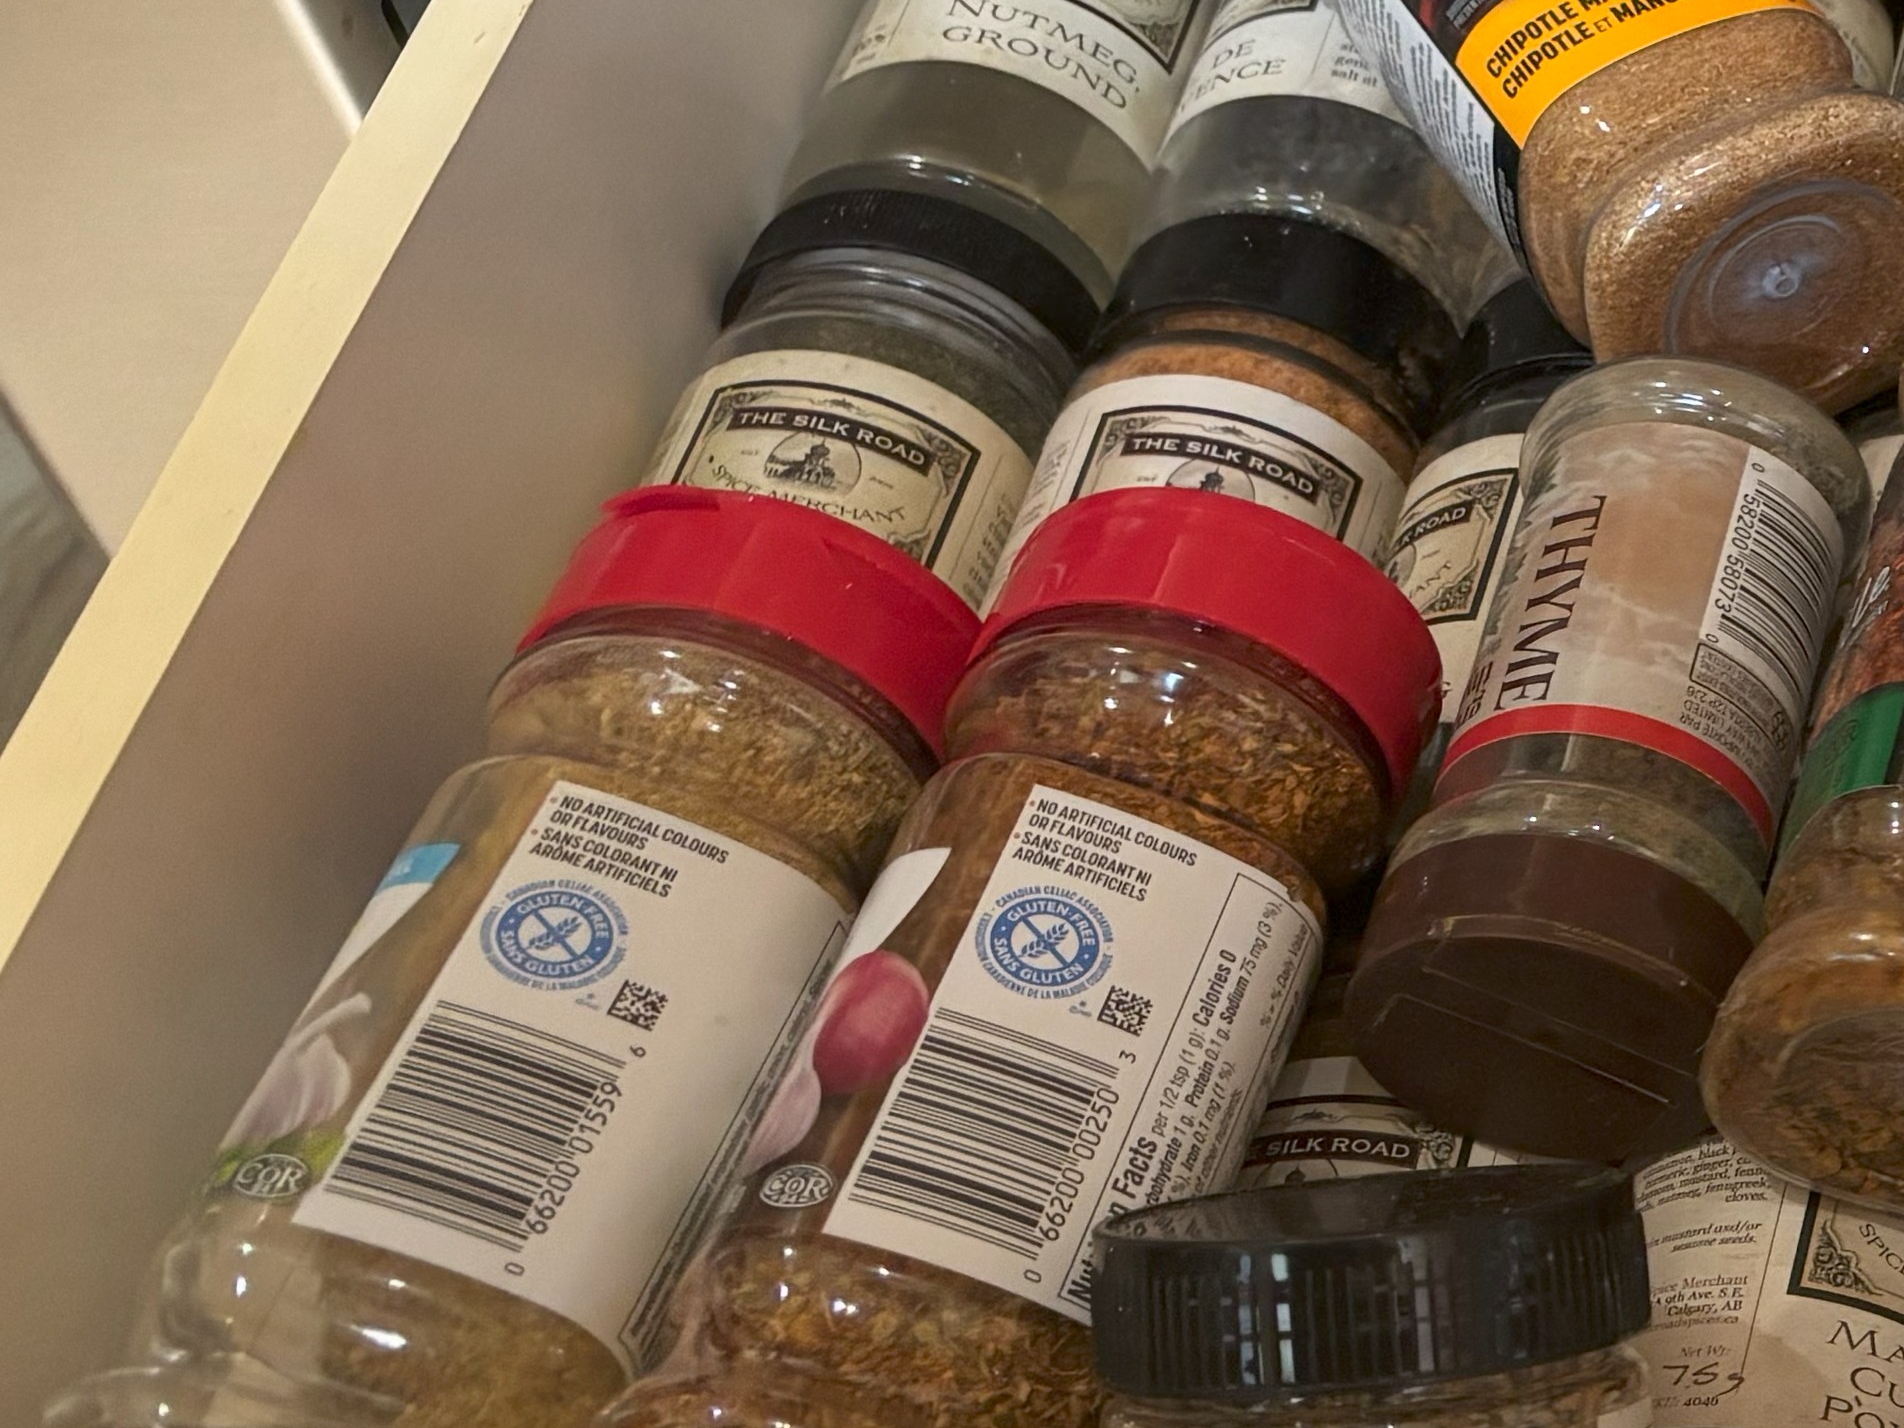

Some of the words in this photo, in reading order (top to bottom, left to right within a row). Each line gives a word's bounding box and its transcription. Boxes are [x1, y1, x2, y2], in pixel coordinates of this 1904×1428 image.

[1212, 39, 1257, 70] DE
[1486, 1, 1579, 79] CHIPOTLE
[1501, 21, 1595, 99] CHIPOTLE
[942, 26, 1128, 110] GROUND
[739, 412, 786, 425] THE
[792, 414, 851, 436] SILK
[856, 428, 926, 466] ROAD
[1131, 437, 1181, 453] THE
[1185, 439, 1242, 464] SILK
[1248, 455, 1314, 495] ROAD
[1413, 506, 1467, 537] ROAD
[1730, 493, 1761, 551] 58200
[1494, 494, 1607, 710] THYME
[1713, 554, 1746, 613] 58073
[540, 827, 584, 849] SANS
[583, 838, 663, 876] COLORANT
[570, 813, 649, 850] FLAVOURS
[583, 801, 661, 839] ARTIFICIAL
[662, 827, 730, 864] COLOURS
[1021, 831, 1062, 852] SANS
[1061, 844, 1137, 879] COLORANT
[1049, 816, 1123, 855] FLAVOURS
[1058, 803, 1132, 842] ARTIFICIAL
[1134, 831, 1198, 867] COLOURS
[583, 858, 673, 898] ARTIFICIELS
[1012, 846, 1066, 872] ARÔME
[1064, 861, 1148, 902] ARTIFICIELS
[1006, 900, 1095, 947] GLUTEN-FREE
[1020, 962, 1084, 985] GLUTEN
[1192, 974, 1232, 1029] Calories
[1219, 975, 1247, 1025] Sodium
[1119, 1050, 1137, 1064] 3
[568, 1081, 623, 1154] 01559
[1072, 1087, 1120, 1160] 00250
[1111, 1135, 1158, 1205] Facts
[1265, 1137, 1325, 1156] SILK
[1330, 1137, 1410, 1158] ROAD
[237, 1160, 302, 1190] COR
[525, 1160, 580, 1235] 66200
[765, 1175, 830, 1197] COR
[1039, 1167, 1085, 1241] 66200
[504, 1262, 525, 1277] 0
[1681, 1275, 1748, 1289] Merchant
[1666, 1303, 1719, 1317] Calgary,
[1683, 1396, 1719, 1408] 4040
